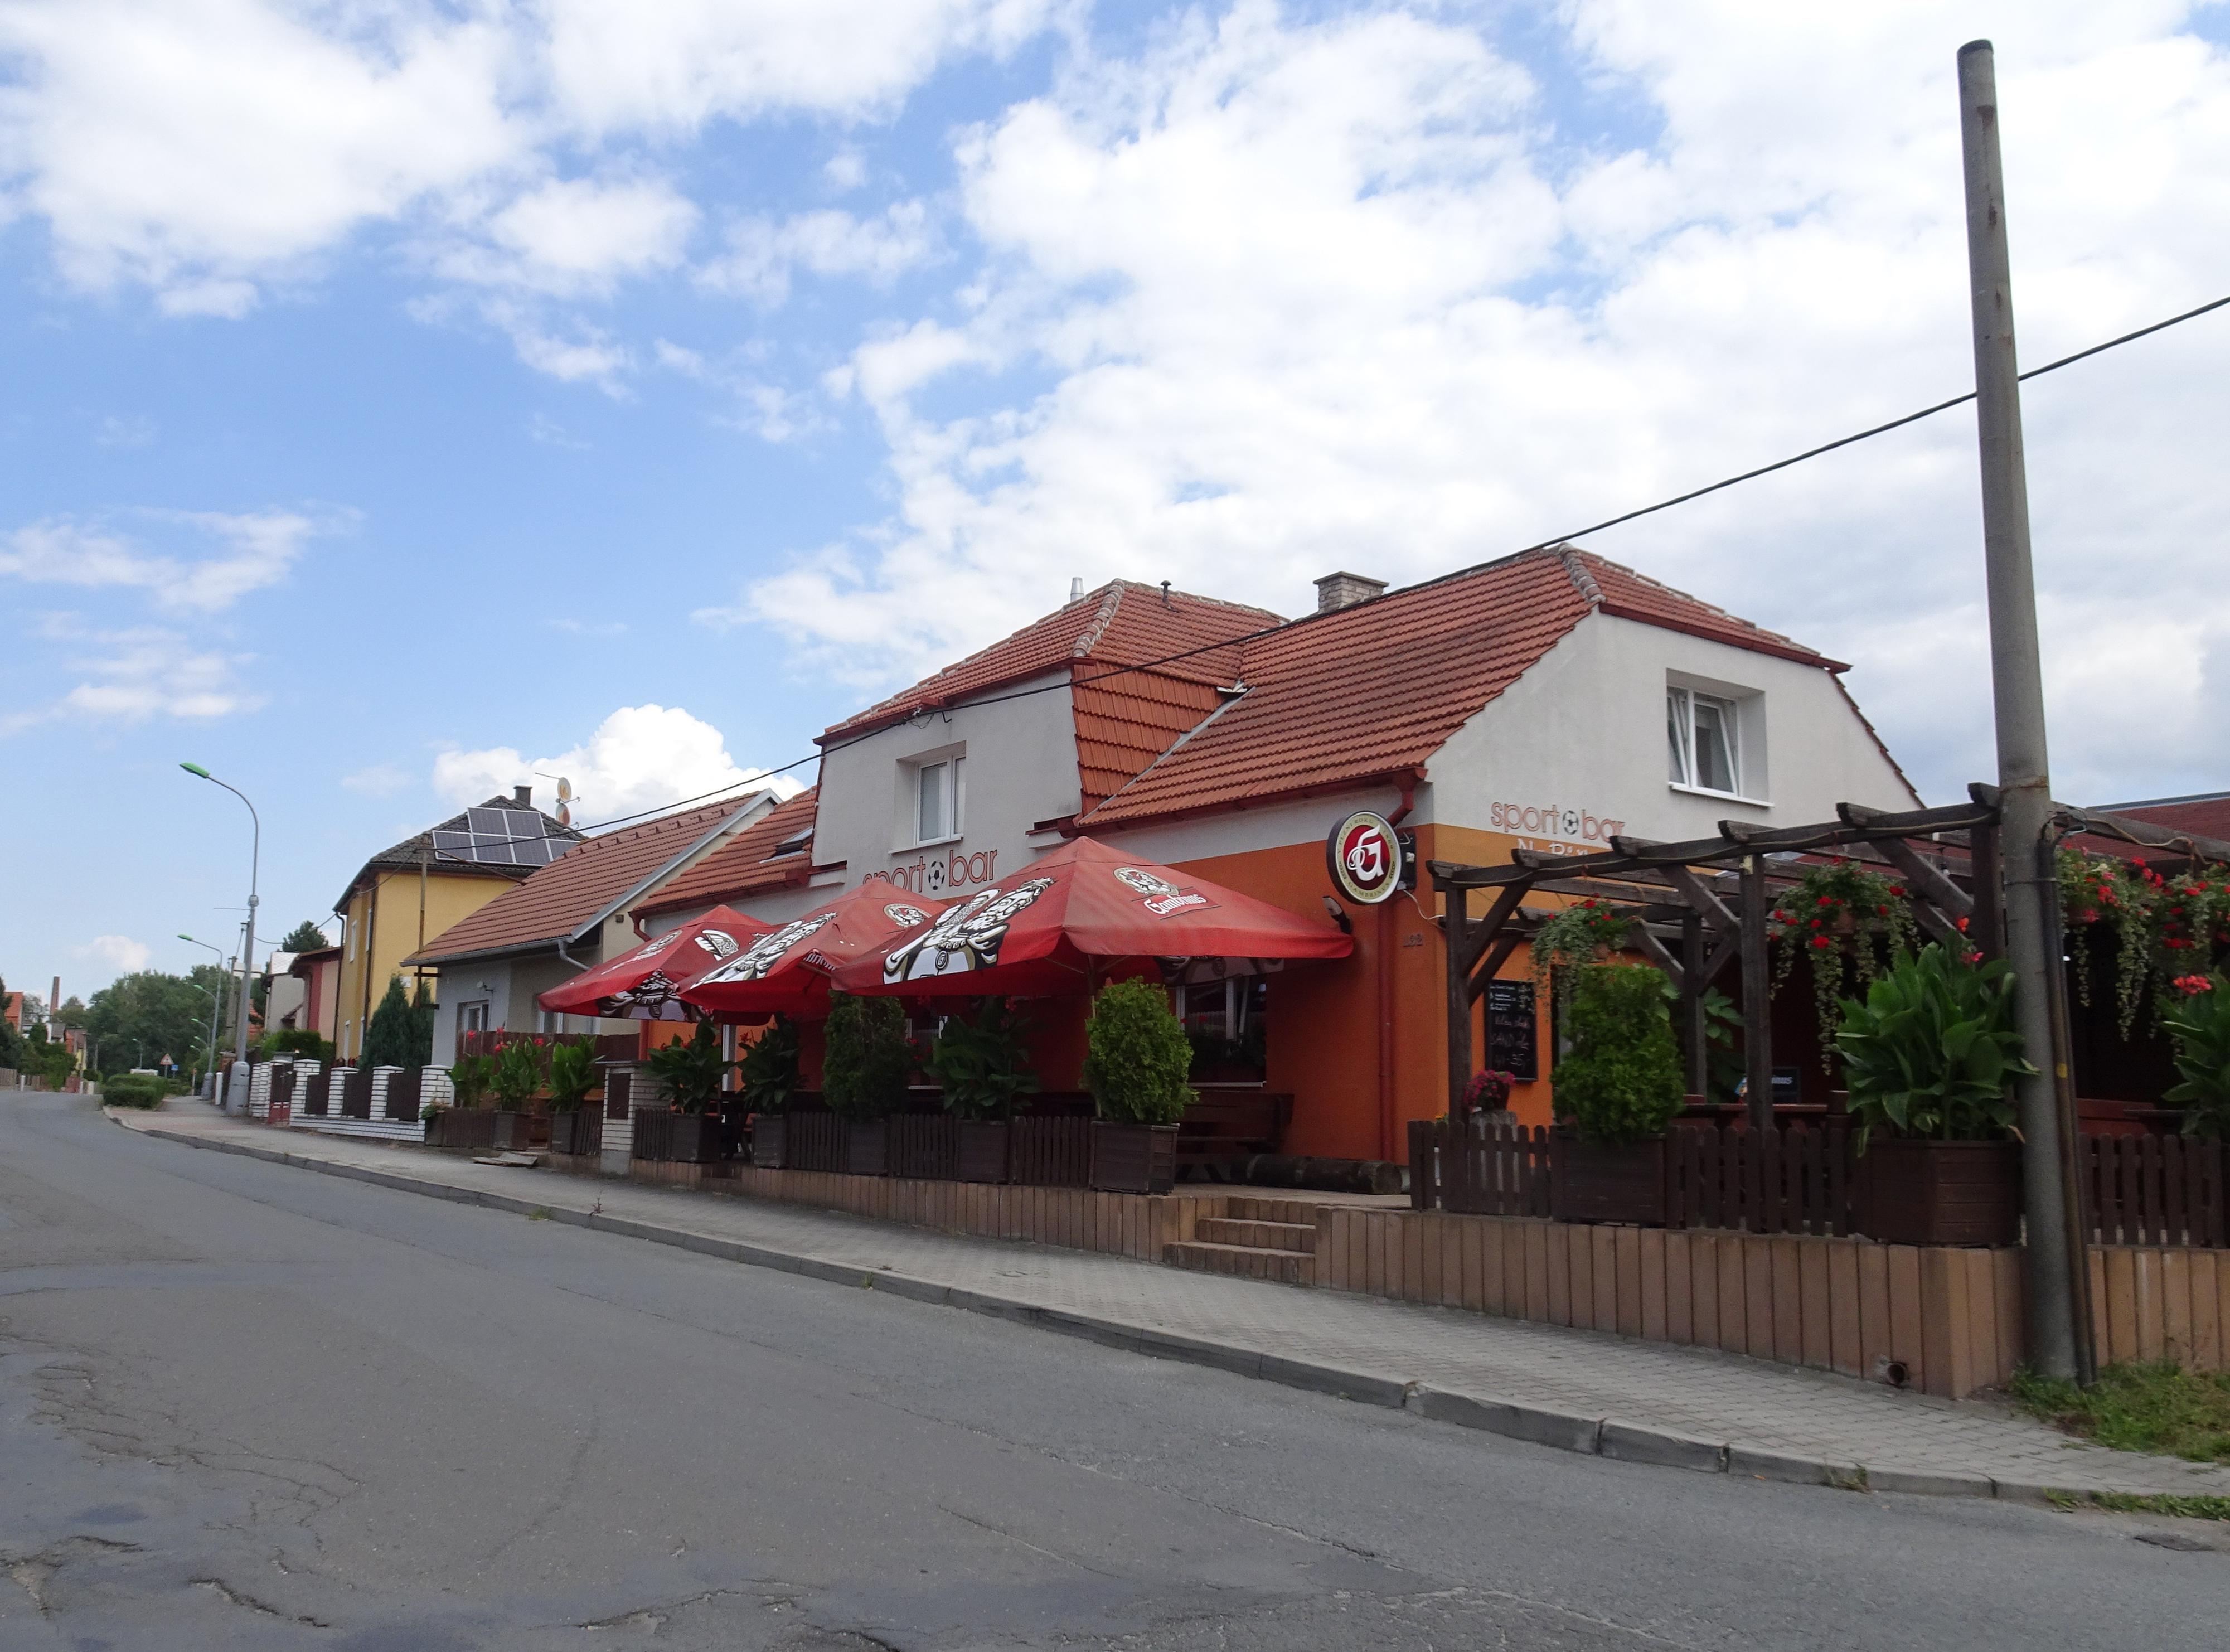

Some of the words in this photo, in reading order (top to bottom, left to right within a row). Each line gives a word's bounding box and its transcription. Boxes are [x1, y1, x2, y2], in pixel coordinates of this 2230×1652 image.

[1491, 802, 1560, 834] sport
[1582, 809, 1625, 843] bar
[949, 849, 998, 887] bar
[1143, 894, 1207, 914] Gambrinus
